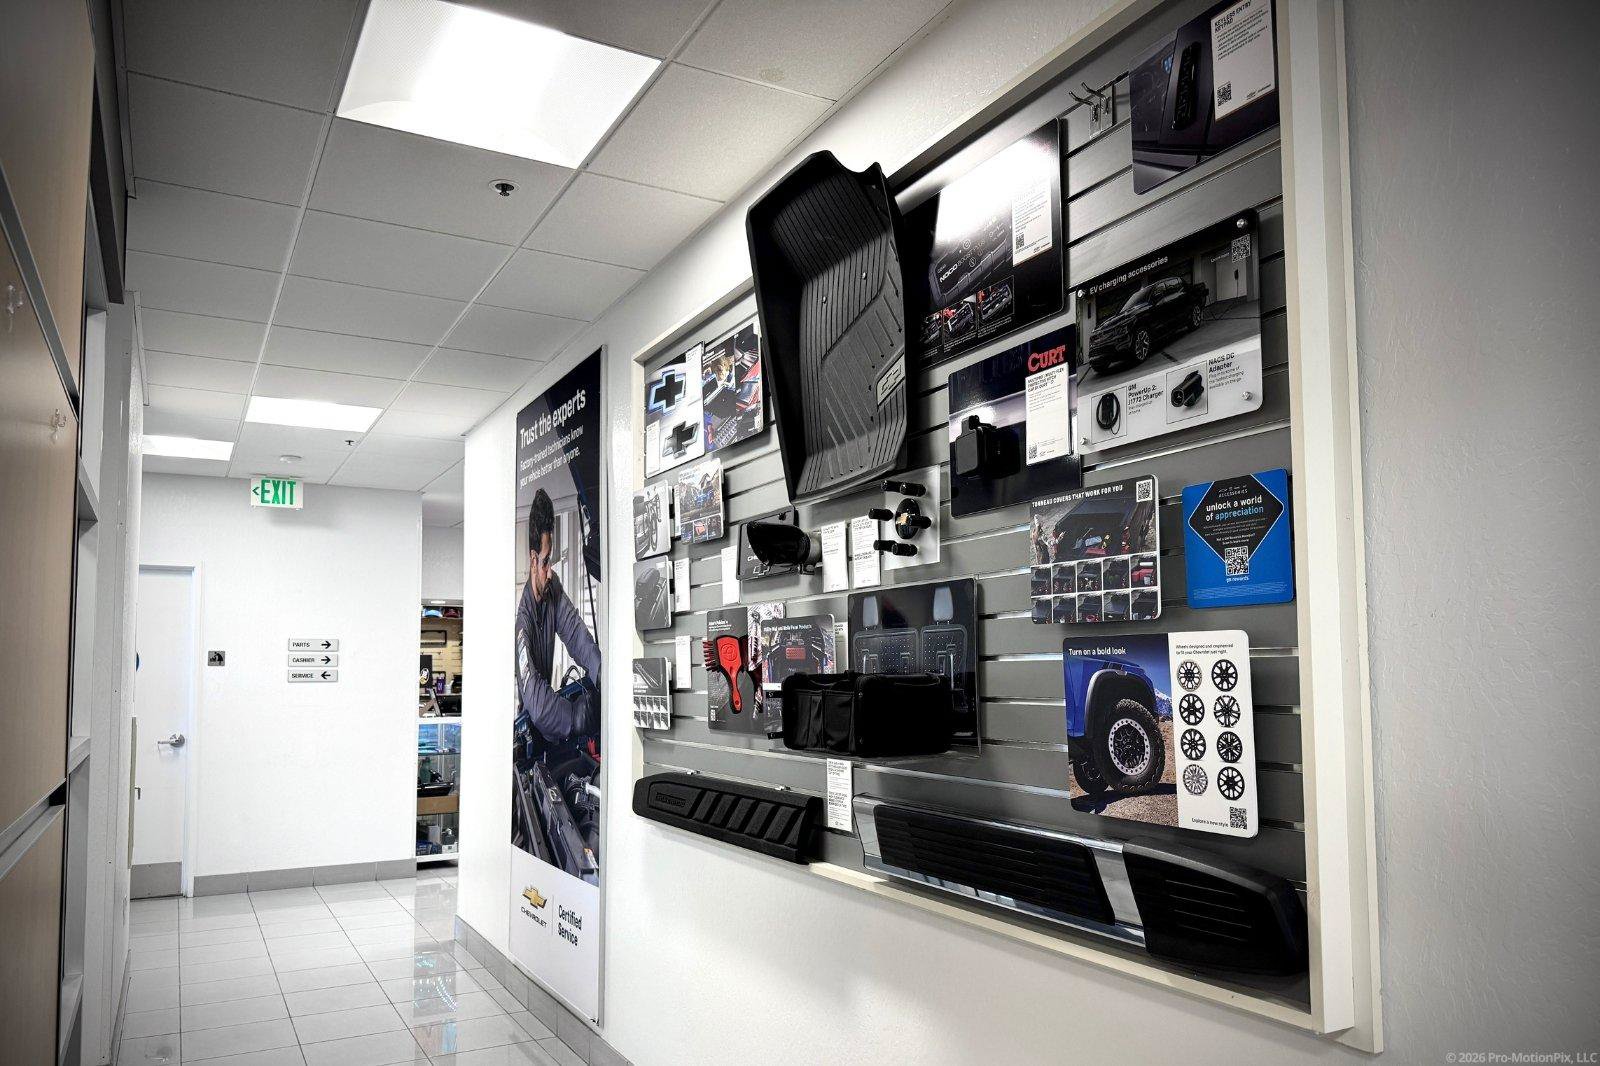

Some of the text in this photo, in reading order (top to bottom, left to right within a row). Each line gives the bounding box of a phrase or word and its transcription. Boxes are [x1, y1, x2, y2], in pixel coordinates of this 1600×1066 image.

[940, 264, 958, 282] NOCO
[1090, 256, 1168, 295] EV charging accessories
[1028, 345, 1066, 371] CURT
[1209, 355, 1225, 365] NACS
[1209, 362, 1232, 373] Adapter
[1128, 387, 1151, 398] PowerUp
[1143, 390, 1164, 400] Charger
[520, 389, 587, 449] Trust the experts
[520, 424, 584, 471] Factory-trained technicians know
[520, 476, 528, 490] your
[529, 470, 541, 482] vehicle
[541, 463, 552, 476] better
[553, 456, 563, 469] than
[261, 479, 296, 505] EXIT
[1032, 484, 1123, 508] TONNEAU COVERS THAT WORK FOR YOU
[1206, 495, 1263, 512] unlock a world
[1205, 506, 1264, 521] of appreciation
[1069, 648, 1082, 656] Turn
[1097, 646, 1111, 655] bold
[1111, 646, 1126, 655] look
[521, 904, 582, 931] CHEVROLET Certified
[558, 921, 578, 946] Service
